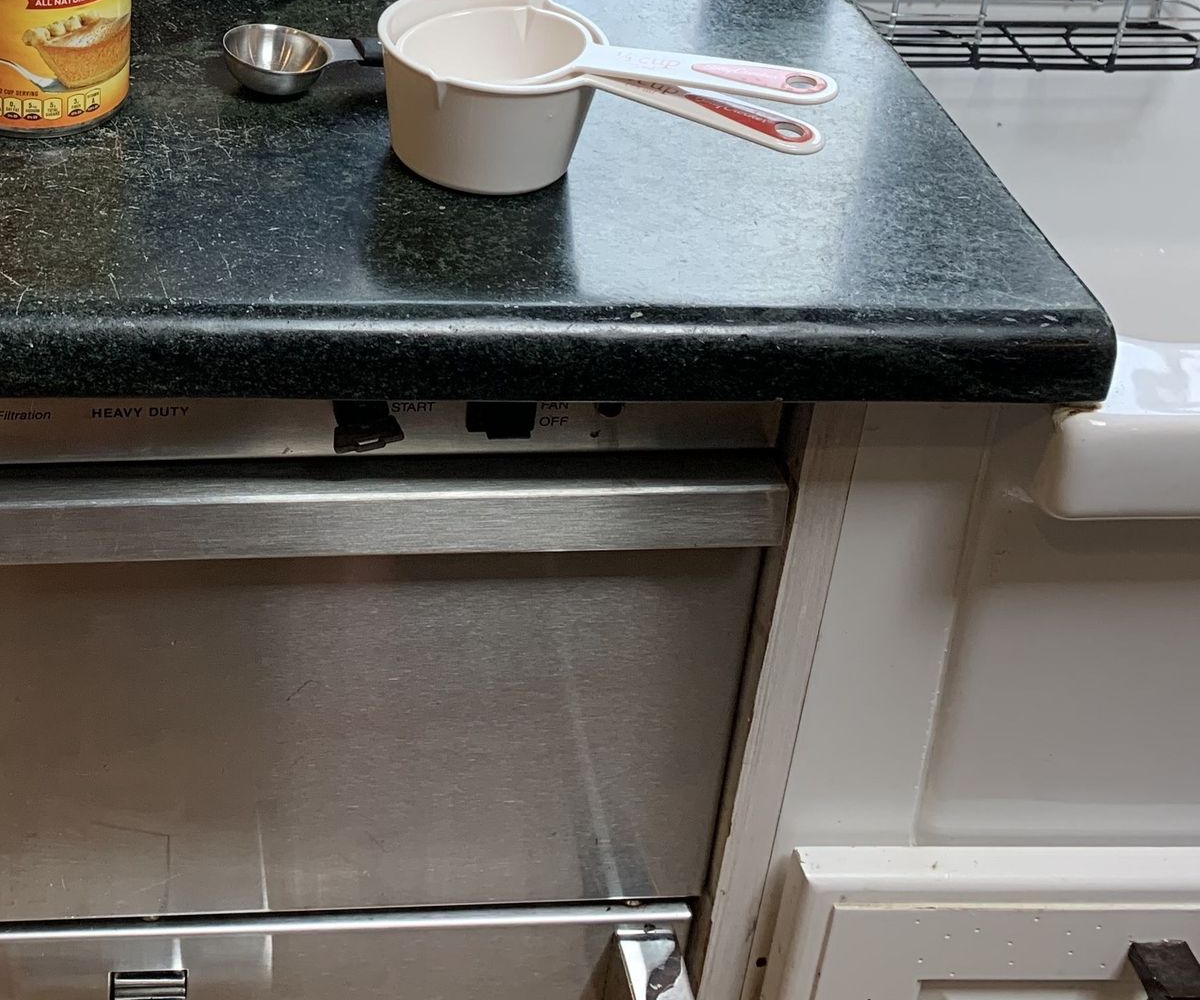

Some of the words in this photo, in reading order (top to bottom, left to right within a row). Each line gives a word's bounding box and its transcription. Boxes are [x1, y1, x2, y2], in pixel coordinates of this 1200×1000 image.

[35, 0, 53, 7] ALL
[91, 407, 143, 418] HEAVY
[149, 405, 190, 417] DUTY
[391, 402, 436, 413] START
[539, 416, 569, 427] OFF
